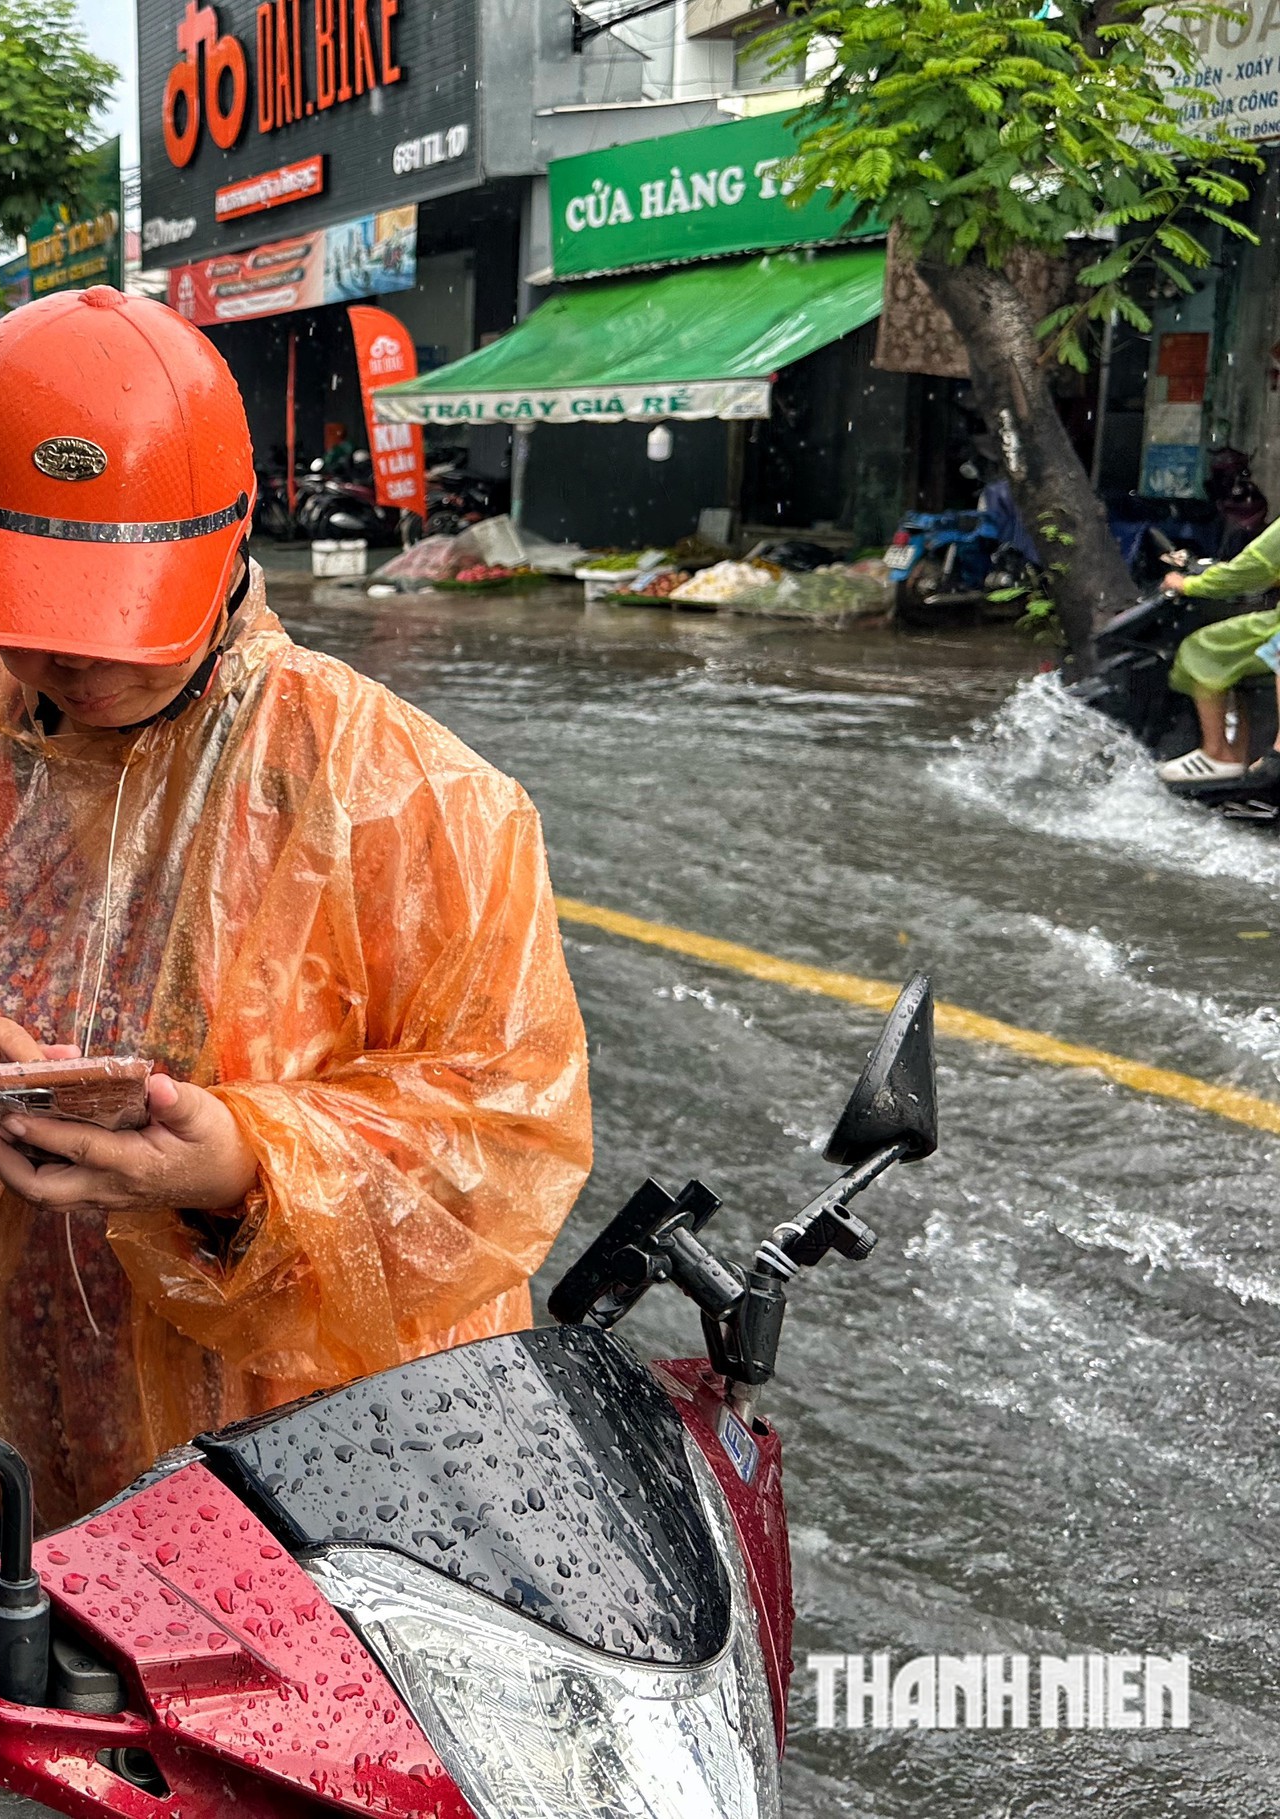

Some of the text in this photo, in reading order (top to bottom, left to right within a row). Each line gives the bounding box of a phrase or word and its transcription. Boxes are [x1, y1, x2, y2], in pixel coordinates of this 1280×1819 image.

[565, 178, 634, 232] CỬA
[640, 166, 746, 220] HÀNG
[420, 399, 484, 419] TRÁI
[495, 398, 557, 418] CÂY
[571, 394, 625, 415] GIÁ
